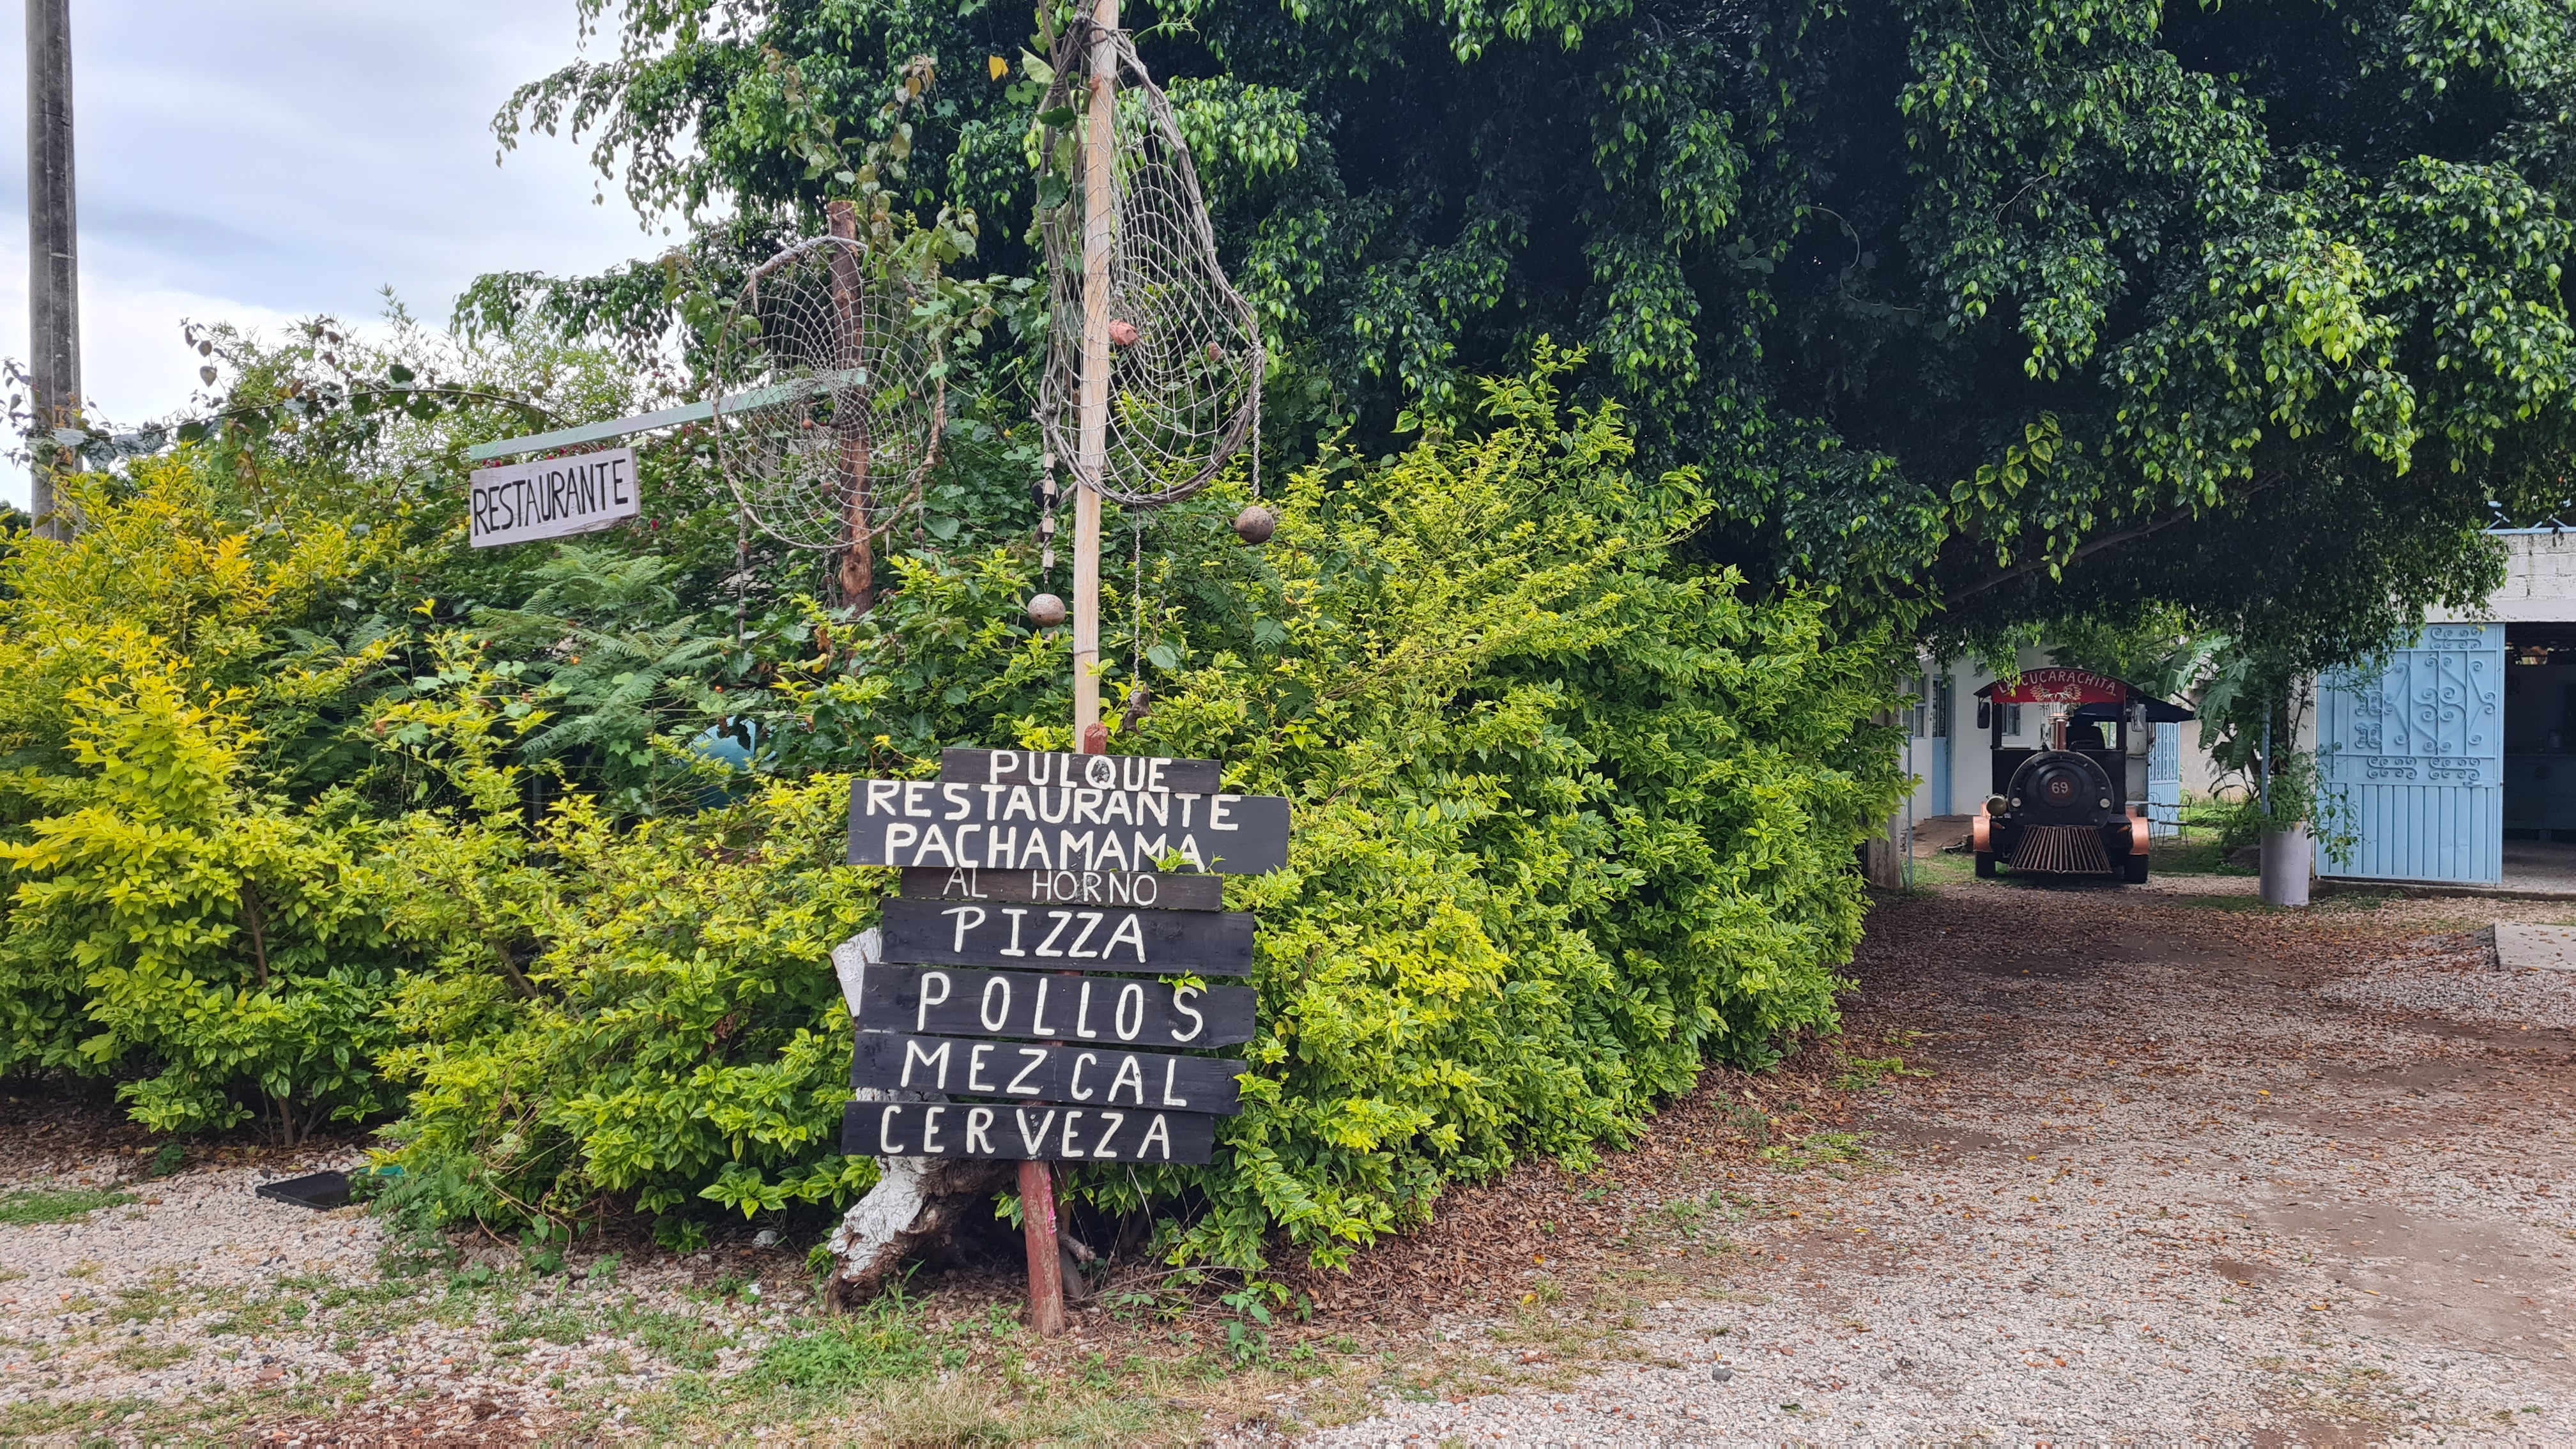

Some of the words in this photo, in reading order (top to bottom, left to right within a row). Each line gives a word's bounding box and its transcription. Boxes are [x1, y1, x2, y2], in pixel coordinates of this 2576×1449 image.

[473, 459, 628, 536] RESTAURANTE
[2021, 671, 2115, 694] CUCARACHITA
[990, 749, 1172, 793] PULQUE
[2051, 781, 2069, 794] 69
[866, 779, 1241, 831] RESTAURANTE
[885, 823, 1205, 873] PACHAMAMA
[943, 868, 988, 898] AL
[1032, 870, 1158, 906] HORNO
[941, 906, 1146, 963] PIZZA
[917, 972, 1204, 1042] POLLOS
[900, 1040, 1187, 1107] MEZCAL
[880, 1105, 1170, 1160] CERVEZA
